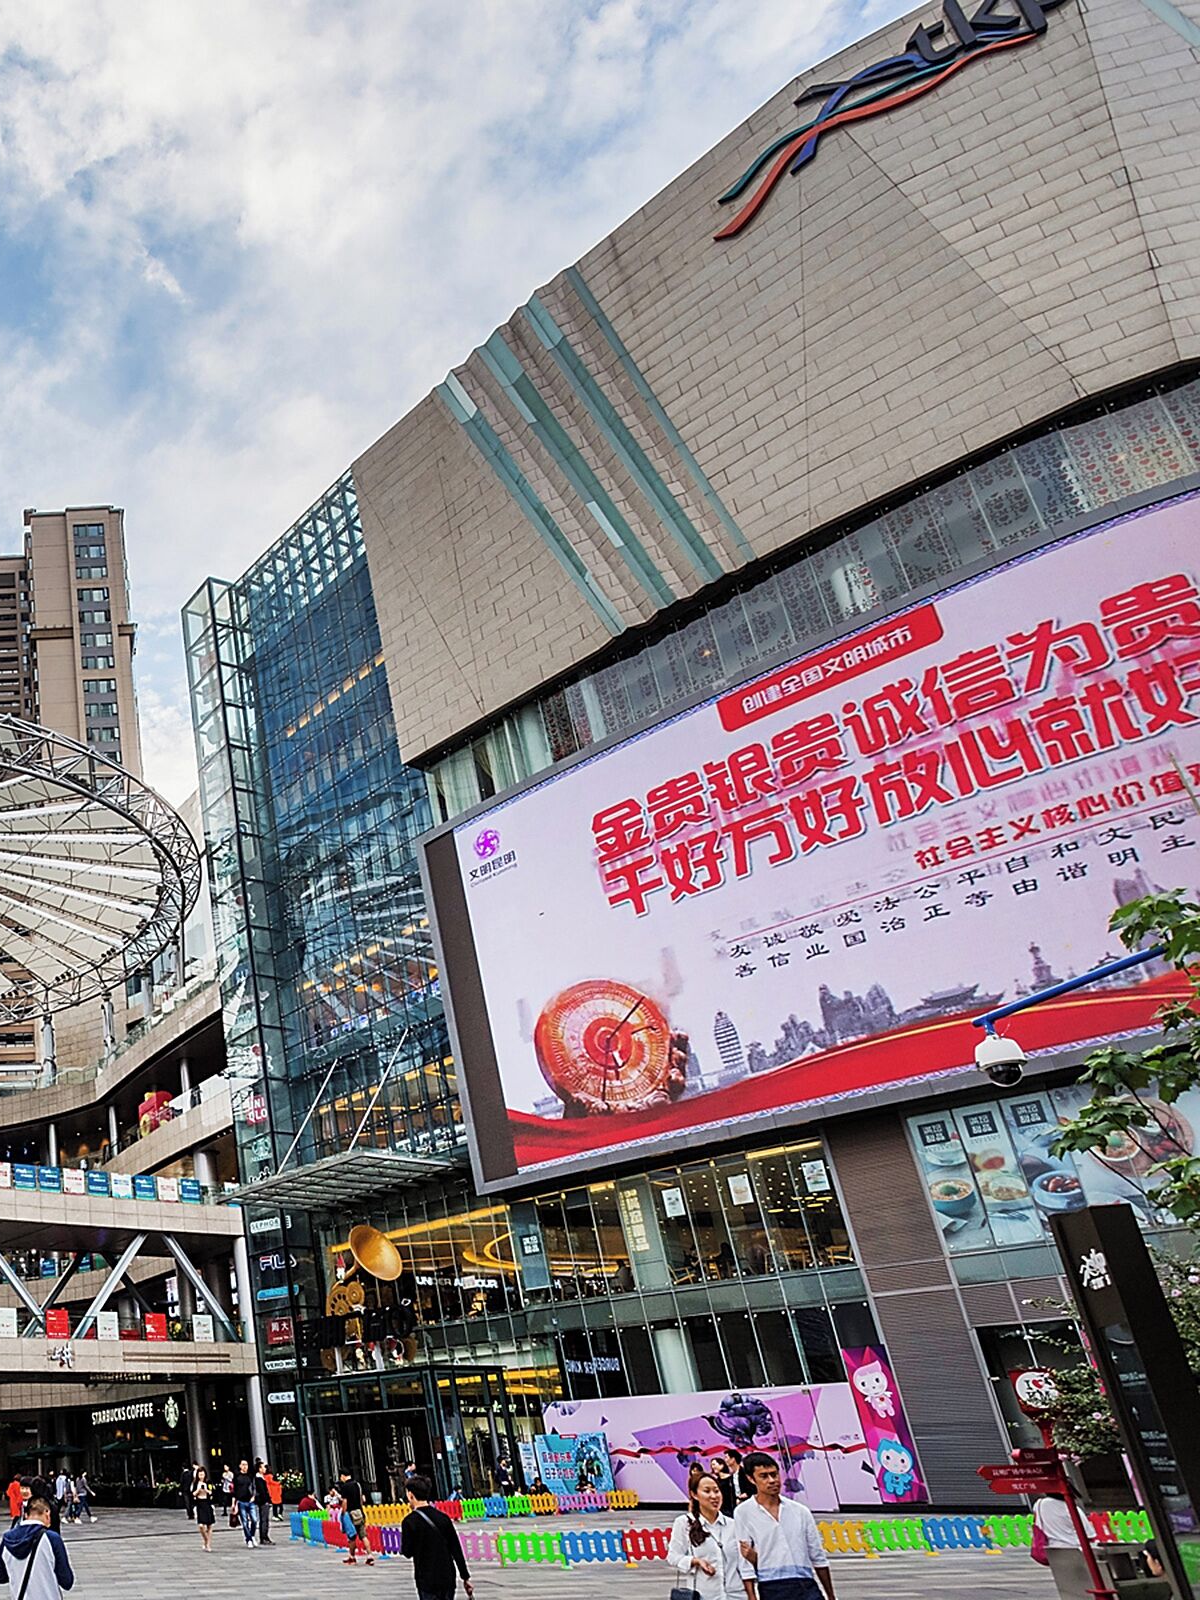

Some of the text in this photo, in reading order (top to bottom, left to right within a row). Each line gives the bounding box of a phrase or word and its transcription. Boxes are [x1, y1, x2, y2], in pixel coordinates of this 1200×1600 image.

[742, 625, 913, 714] 创建全国文明城市
[591, 573, 1200, 864] 金贵银贵诚信为贵
[603, 650, 1200, 915] 千好万好放心就好
[469, 850, 516, 881] 文明昆明
[454, 1277, 498, 1289] AOUR
[92, 1403, 153, 1425] STARBUCKS COFFEE
